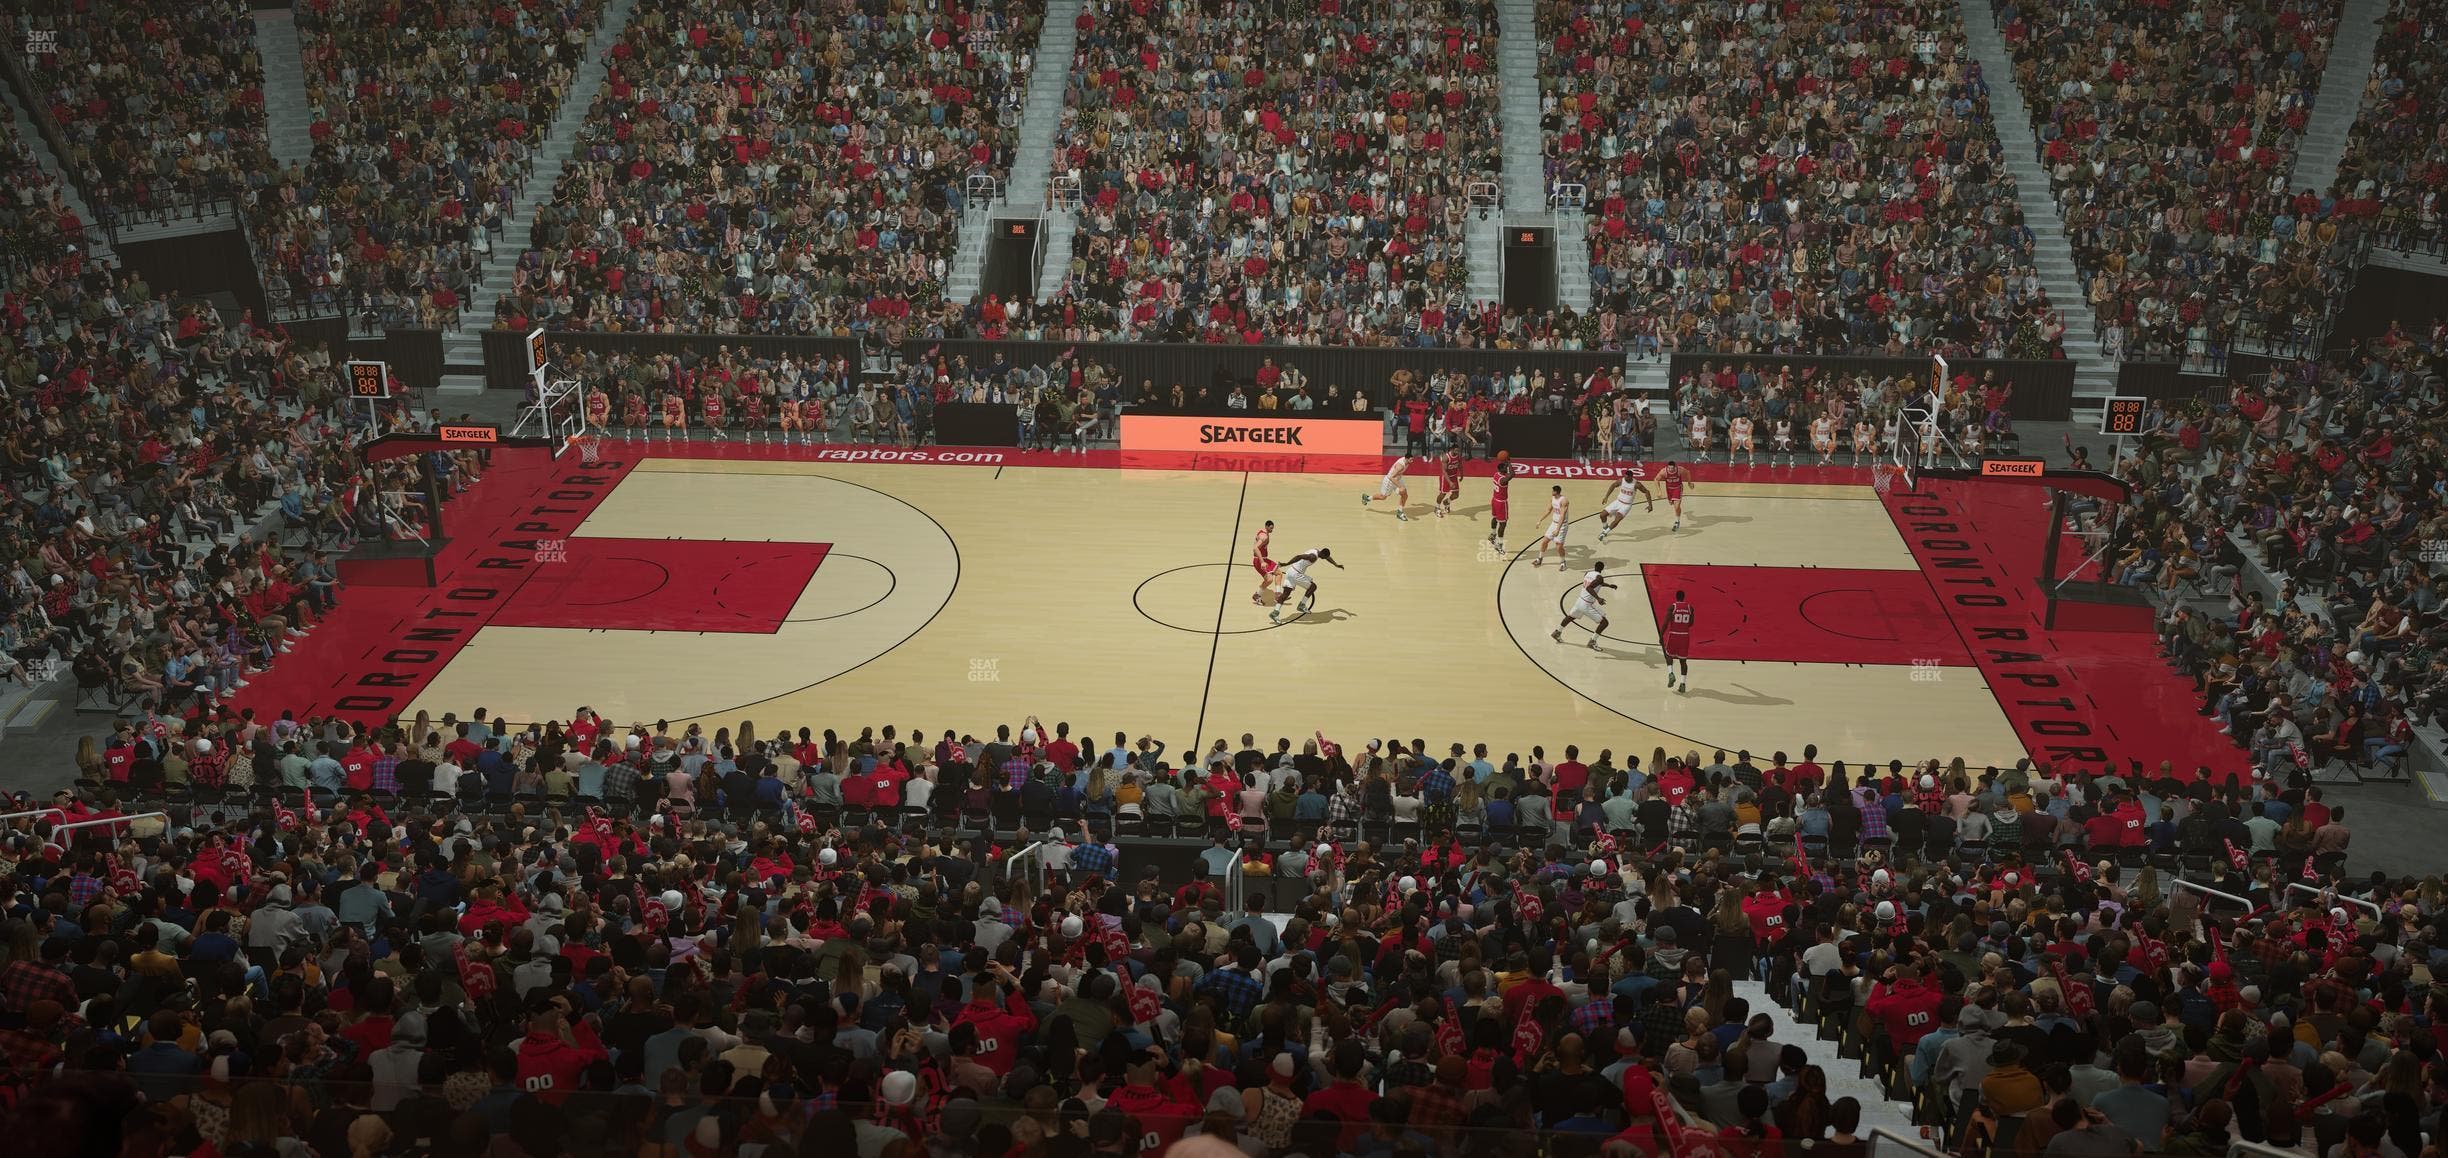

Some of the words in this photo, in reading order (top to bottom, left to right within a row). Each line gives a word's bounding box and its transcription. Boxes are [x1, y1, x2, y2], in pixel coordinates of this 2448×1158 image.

[359, 378, 377, 394] 88
[2114, 414, 2135, 431] 88
[446, 429, 490, 440] SEATGEEK
[1200, 425, 1303, 446] SEATGEEK
[817, 449, 1004, 464] raptors.com
[1509, 462, 1646, 481] @raptors
[1989, 463, 2036, 474] SEATGEEK
[335, 587, 499, 714] ORONTO
[477, 461, 624, 569] RAPTORS
[1674, 613, 1691, 623] 00
[1893, 492, 2007, 608] TORONTO
[1974, 626, 2108, 768] RAPTOR
[112, 755, 124, 764] 00
[349, 763, 362, 772] 00
[877, 780, 890, 789] 00
[1672, 786, 1684, 795] 00
[2127, 819, 2140, 828] 00
[1767, 915, 1783, 926] 00
[1907, 1011, 1929, 1026] 00
[526, 1073, 554, 1092] 00
